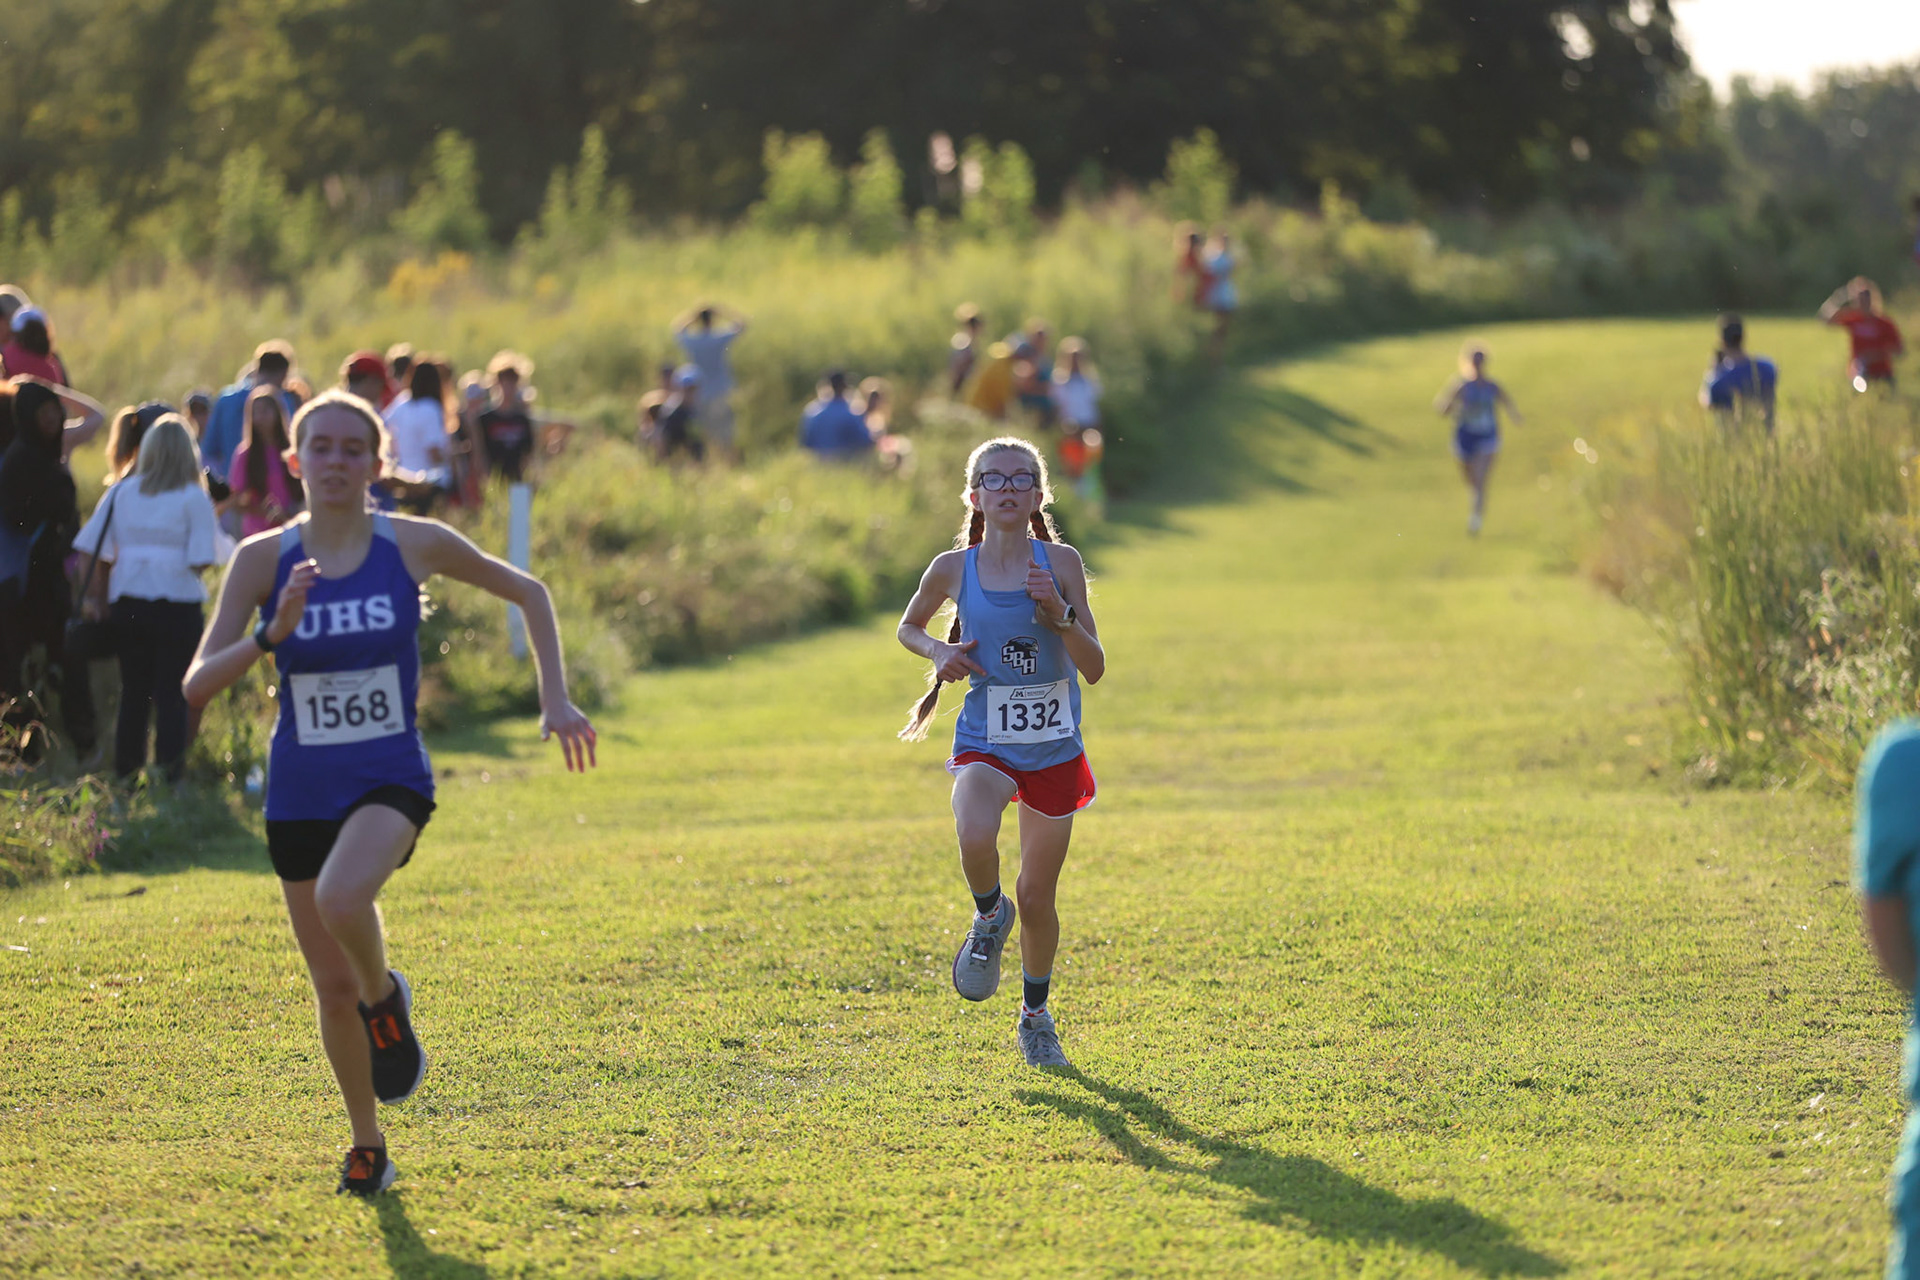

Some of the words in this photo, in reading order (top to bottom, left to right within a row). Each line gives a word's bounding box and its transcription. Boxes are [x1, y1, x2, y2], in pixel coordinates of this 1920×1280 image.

[295, 594, 395, 639] UHS
[1003, 645, 1036, 675] SBA
[306, 690, 389, 729] 1568
[998, 699, 1061, 731] 1332
